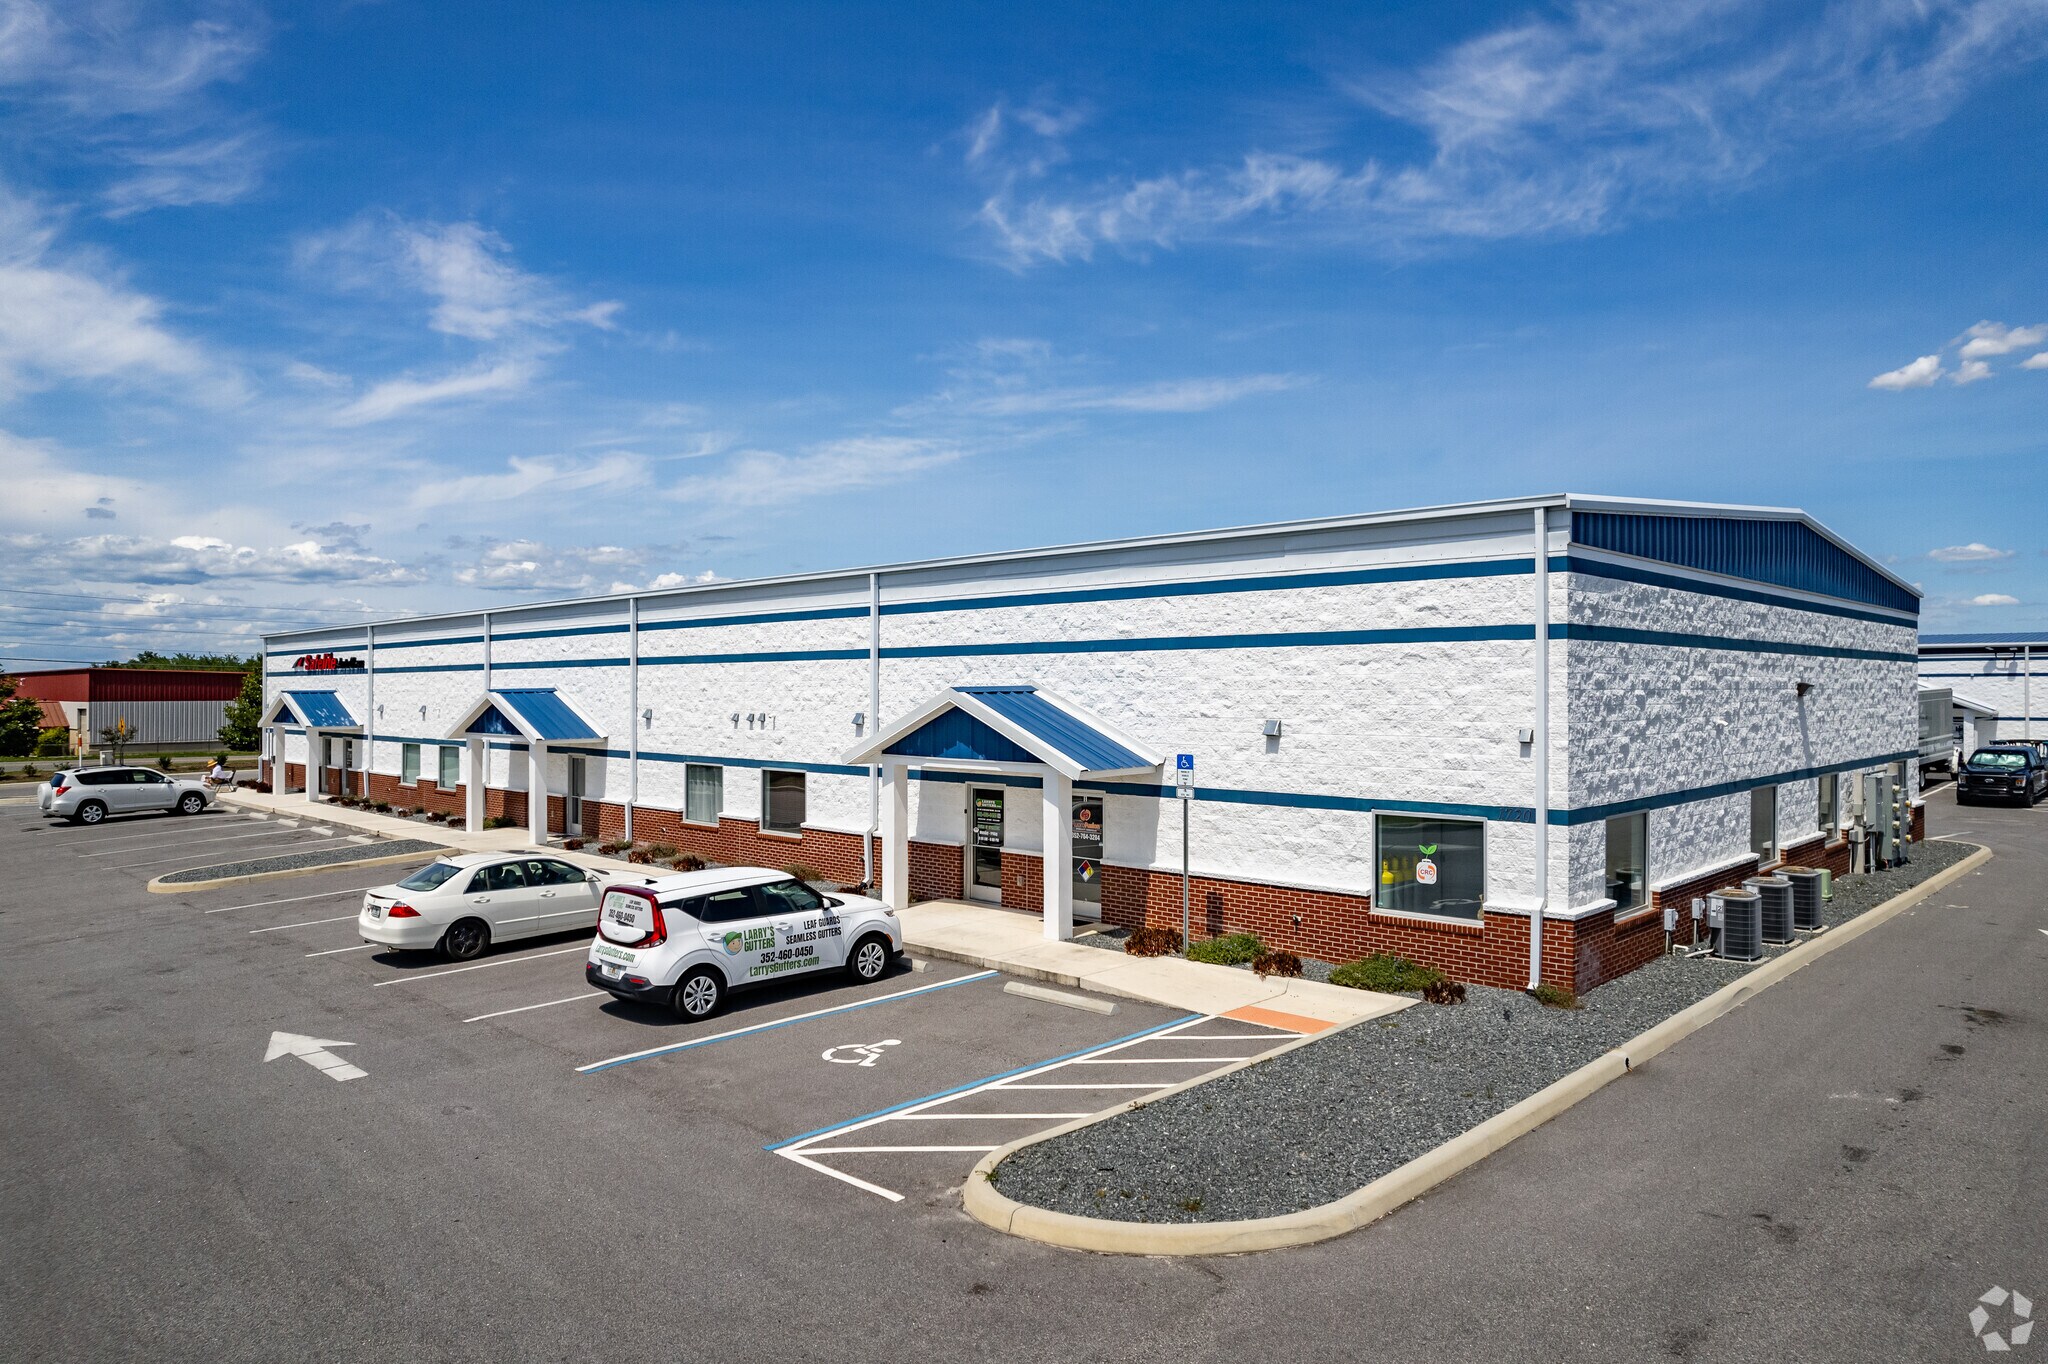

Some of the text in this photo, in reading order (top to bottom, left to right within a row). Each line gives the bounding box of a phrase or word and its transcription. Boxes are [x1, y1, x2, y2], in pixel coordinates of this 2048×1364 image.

[803, 915, 841, 930] LEAF GUARDS
[743, 925, 775, 941] LARRY'S
[785, 926, 842, 945] SEAMLESS GUTTERS
[744, 937, 776, 952] GUTTERS
[760, 945, 814, 964] 352-460-0450
[749, 956, 820, 977] LarrysGutters.com
